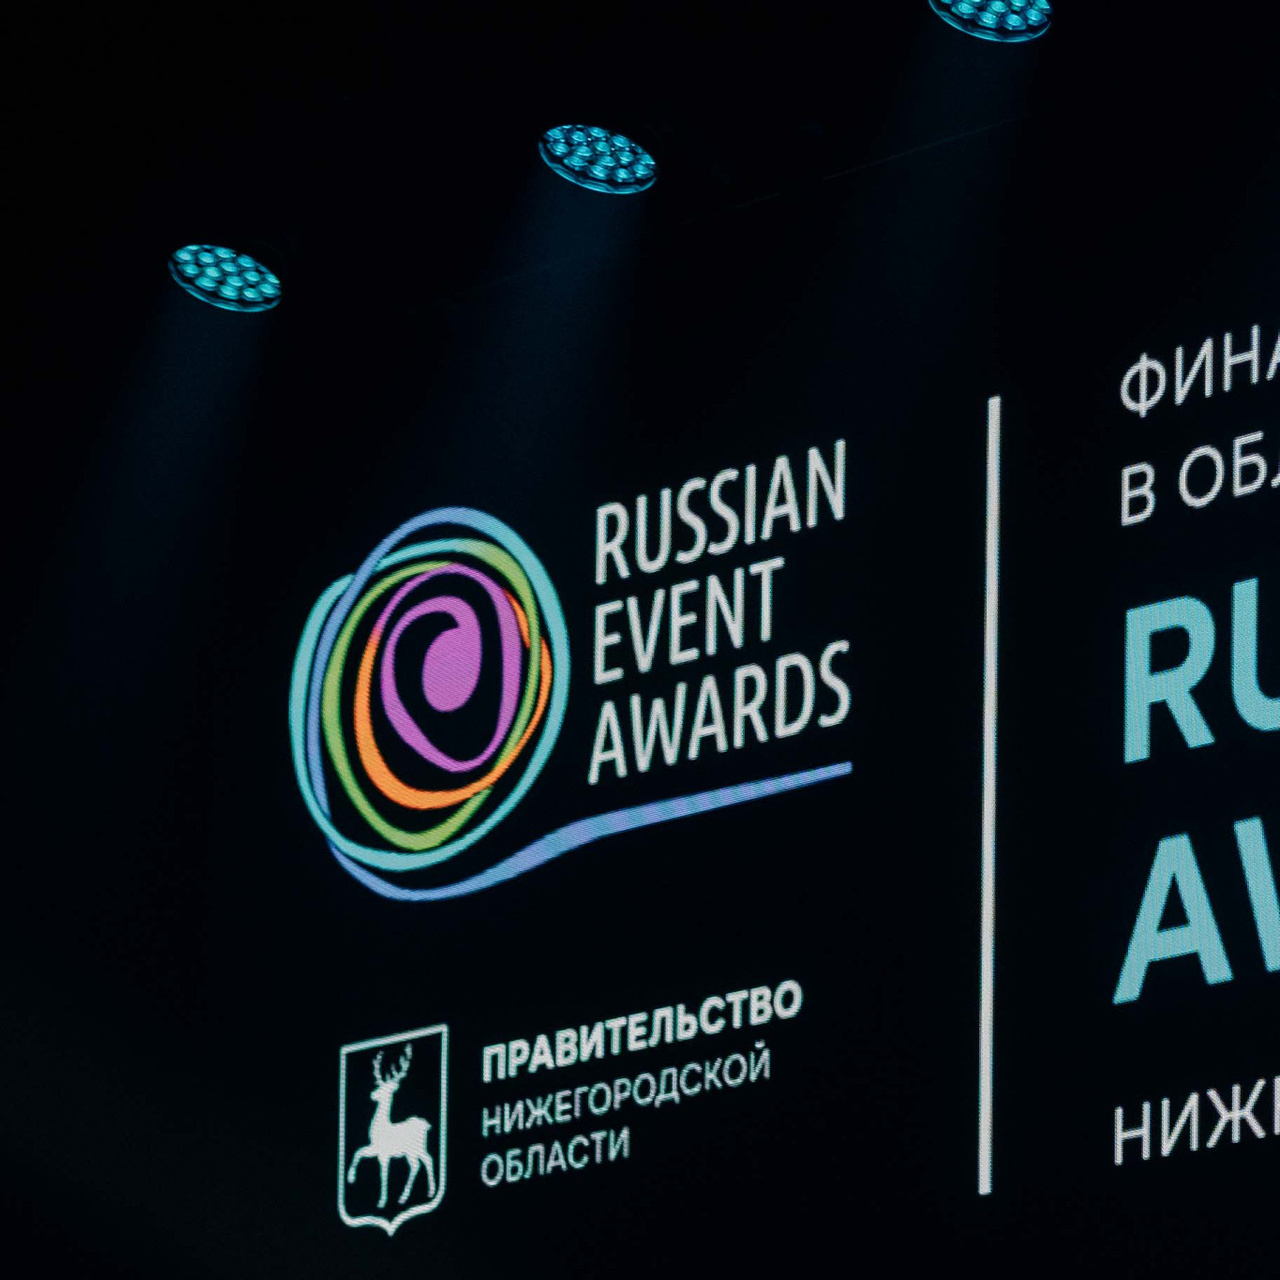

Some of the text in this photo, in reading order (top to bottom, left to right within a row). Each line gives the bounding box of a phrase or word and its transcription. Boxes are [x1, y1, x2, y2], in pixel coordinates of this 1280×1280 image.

[595, 438, 847, 586] RUSSIAN
[1121, 431, 1280, 526] В ОБ
[593, 556, 786, 685] EVENT
[587, 639, 852, 786] AWARDS
[482, 979, 804, 1084] ПРАВИТЕЛЬСТВО
[481, 1040, 771, 1138] НИЖЕГОРОДСКОЙ
[1113, 1074, 1280, 1166] НИЖ
[480, 1126, 631, 1188] ОБЛАСТИ
